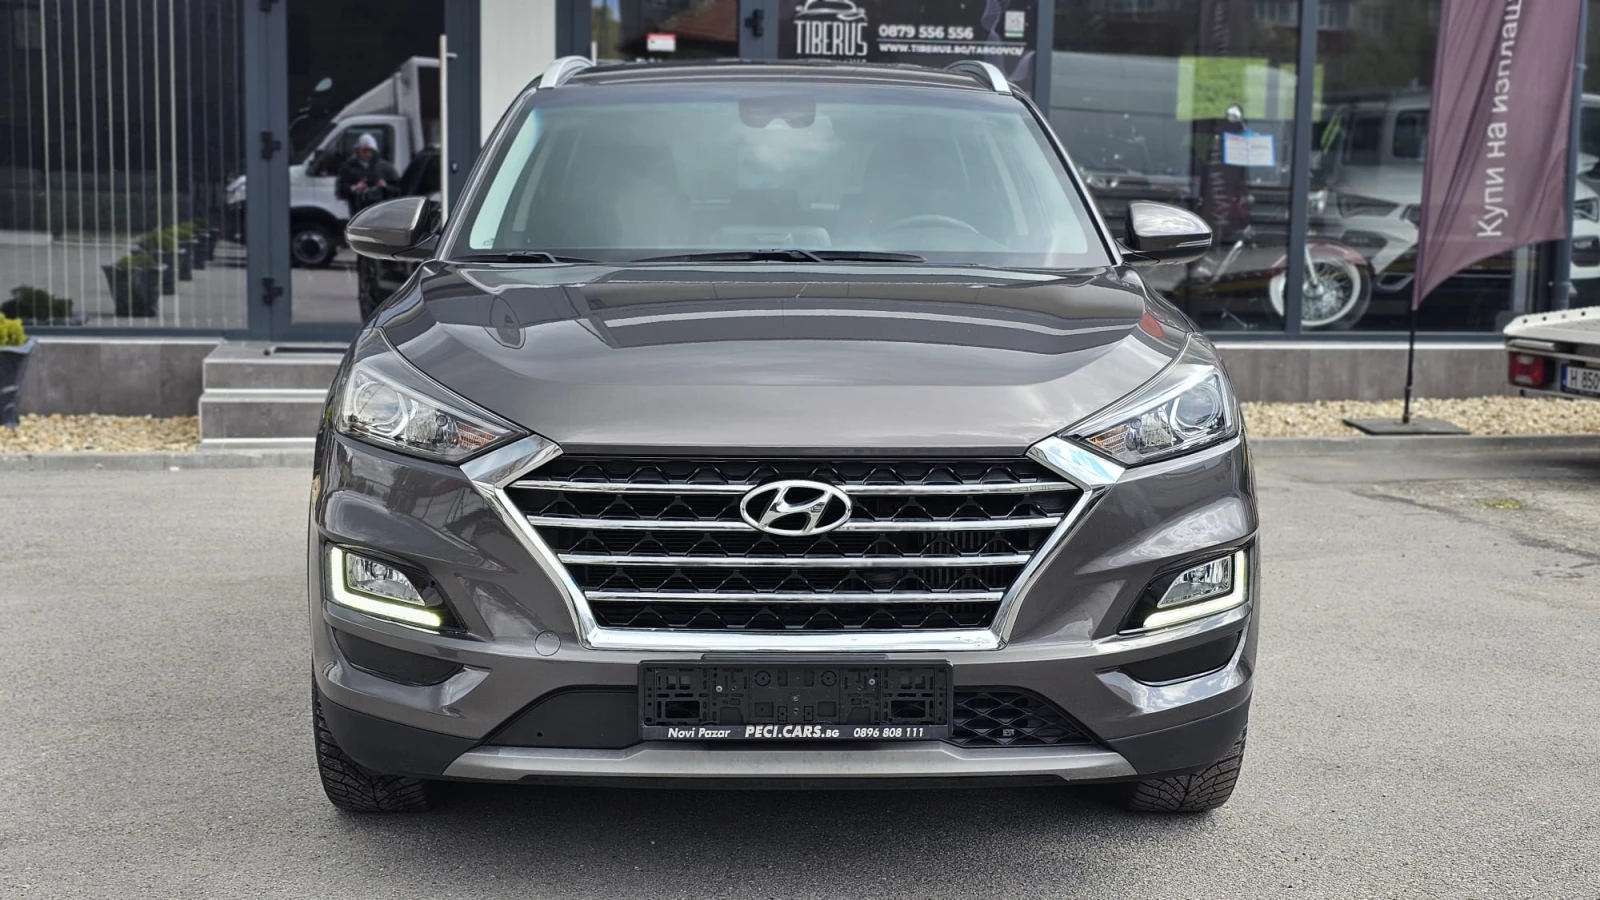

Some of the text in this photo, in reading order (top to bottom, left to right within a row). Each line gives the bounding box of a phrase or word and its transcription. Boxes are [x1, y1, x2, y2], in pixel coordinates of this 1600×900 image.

[793, 20, 868, 56] TIBERUS
[878, 24, 974, 40] 0879 556 556
[1486, 121, 1508, 158] на
[1476, 166, 1509, 238] Купи
[667, 727, 696, 738] Novi
[698, 727, 732, 738] Pazar
[853, 727, 880, 738] 0896
[882, 727, 903, 738] 808
[906, 727, 924, 738] 111
